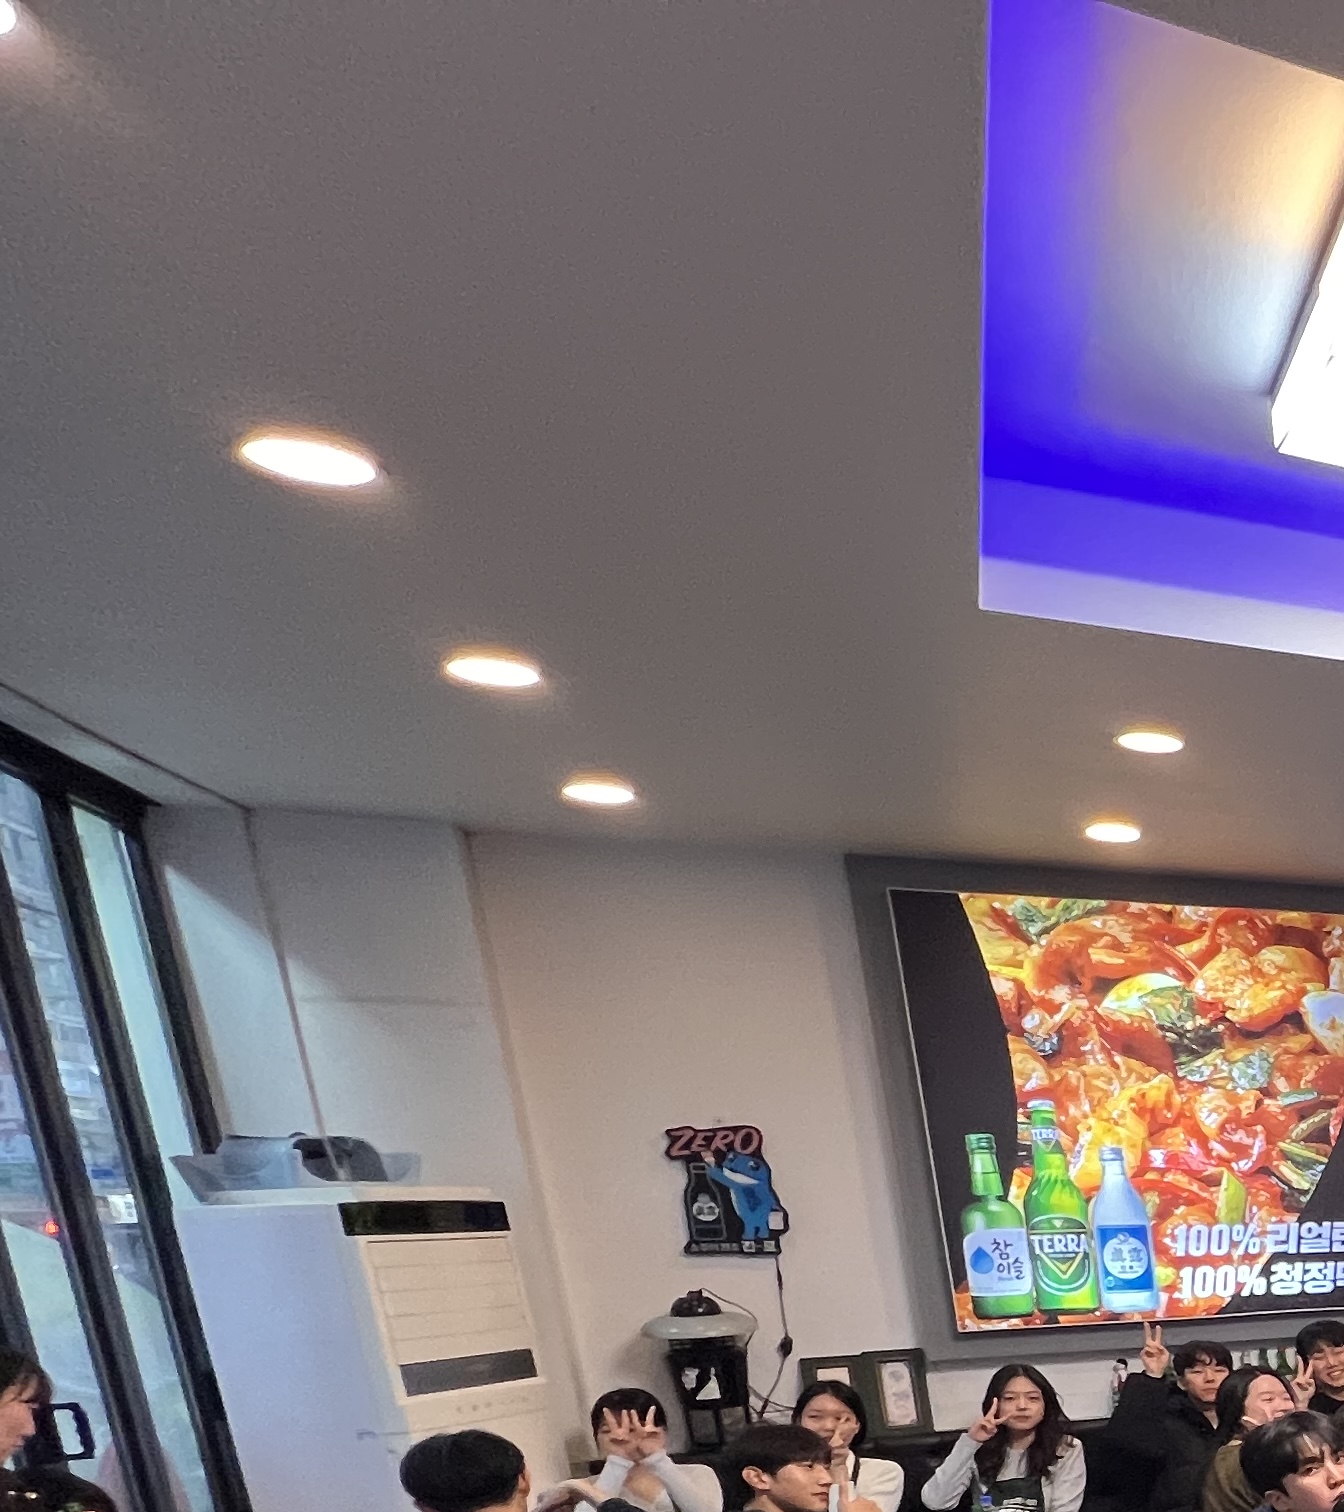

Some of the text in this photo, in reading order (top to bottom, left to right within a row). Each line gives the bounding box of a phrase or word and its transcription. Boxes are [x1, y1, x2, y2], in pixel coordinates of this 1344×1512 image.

[668, 1127, 761, 1157] ZERO
[991, 1237, 1014, 1261] 참
[1030, 1233, 1089, 1255] TERRA
[1173, 1223, 1261, 1257] 100%
[996, 1257, 1025, 1280] 이슬
[1176, 1264, 1268, 1300] 100%
